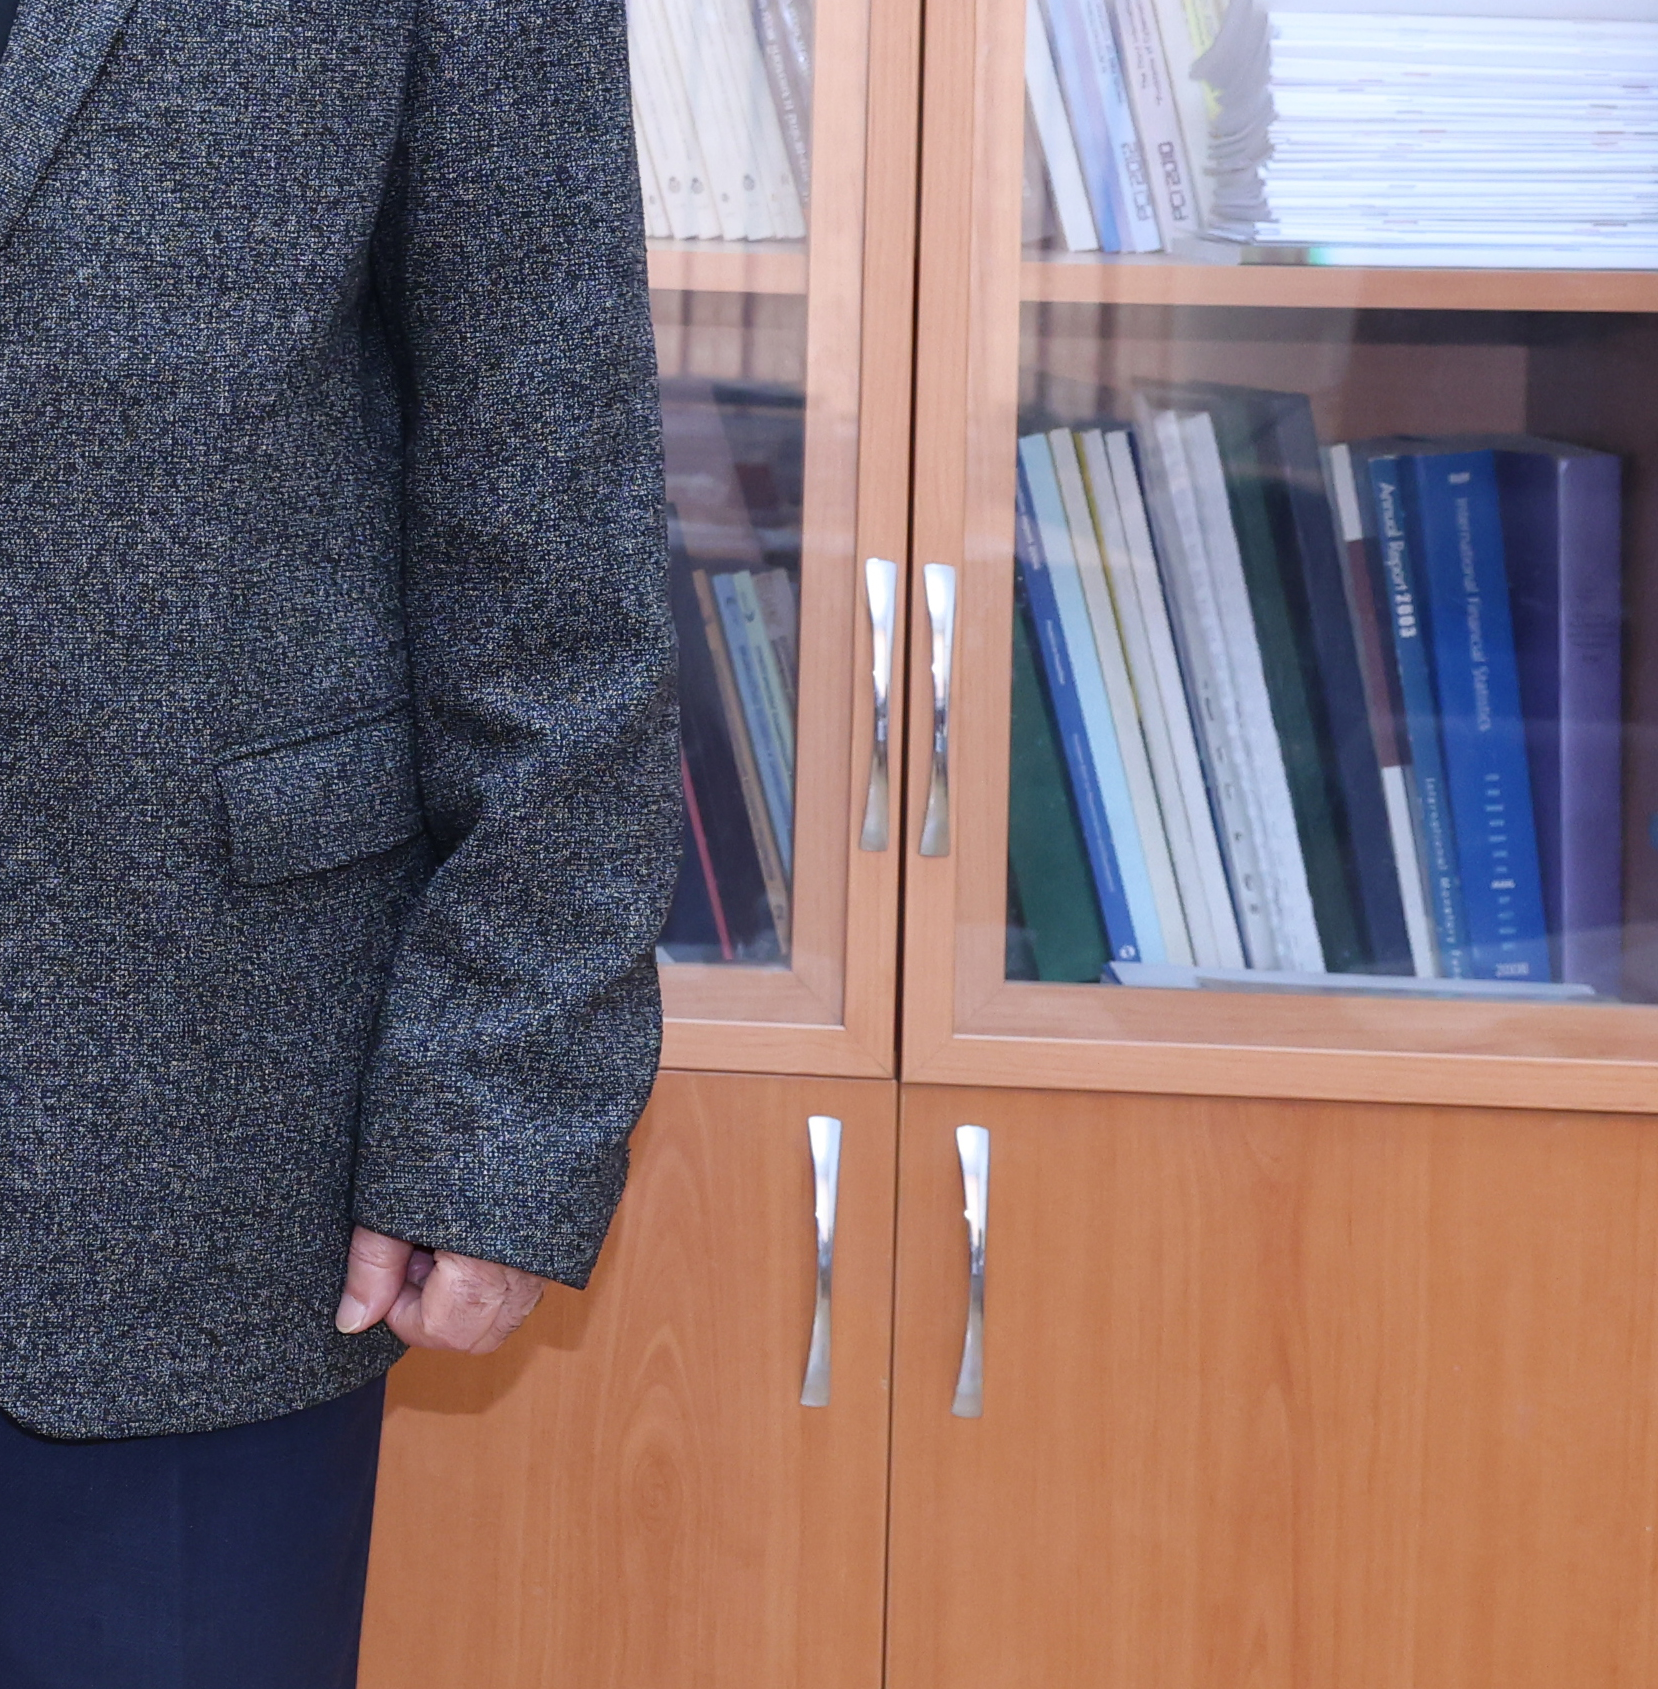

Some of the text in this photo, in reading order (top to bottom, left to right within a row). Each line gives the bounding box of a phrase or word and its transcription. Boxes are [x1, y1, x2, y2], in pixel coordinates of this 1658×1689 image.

[1378, 480, 1403, 538] Annual
[1382, 540, 1410, 591] Report
[1453, 496, 1493, 733] International Financial Statistics
[1436, 875, 1458, 942] Monetary
